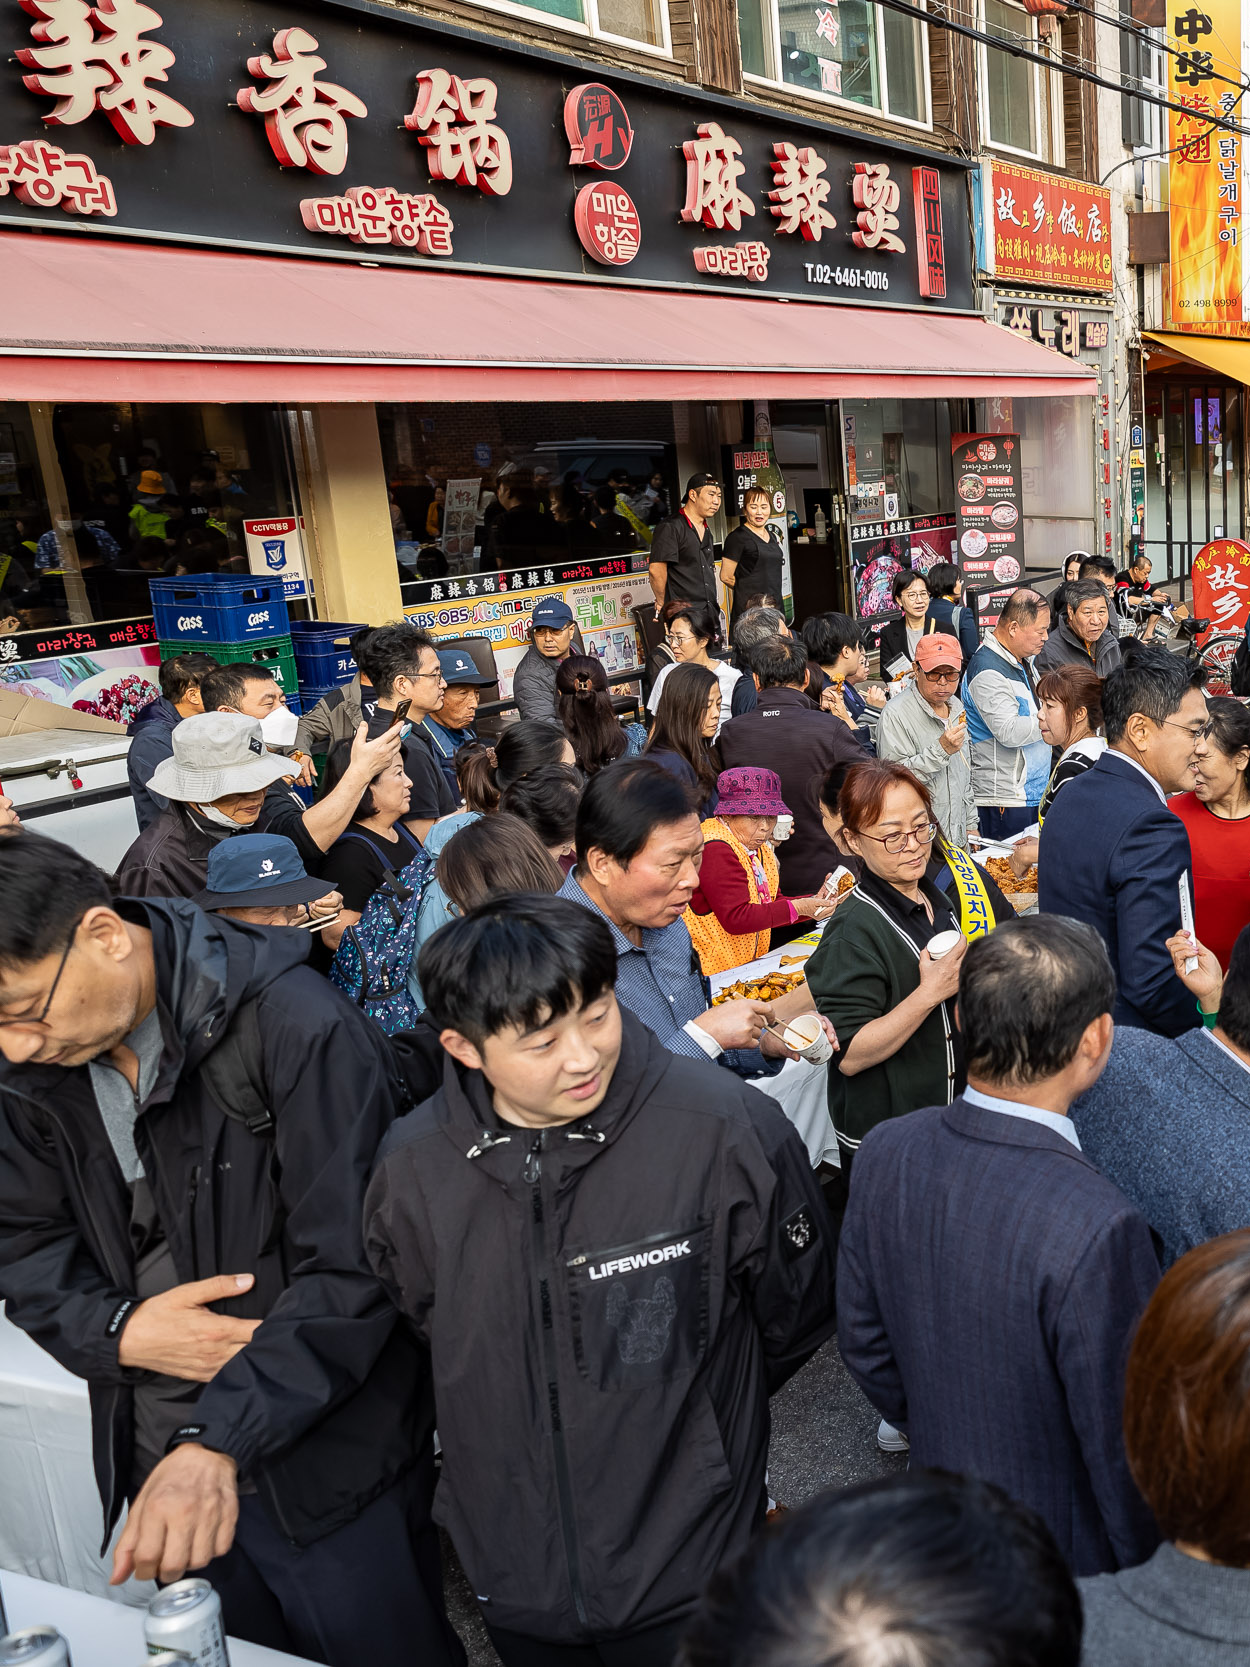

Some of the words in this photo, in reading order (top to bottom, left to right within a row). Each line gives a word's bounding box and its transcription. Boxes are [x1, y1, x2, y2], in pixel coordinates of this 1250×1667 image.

[1174, 8, 1214, 165] 中华烤翅
[681, 121, 906, 254] 麻辣烫
[592, 192, 636, 229] 매운
[995, 187, 1102, 244] 故乡饭店
[922, 169, 945, 297] 四川风味
[697, 243, 771, 282] 마라탕
[805, 262, 889, 291] T.02-6461-0016
[1178, 300, 1191, 308] 02
[1194, 299, 1211, 308] 498
[1214, 298, 1238, 308] 8999
[1085, 321, 1109, 348] 연습장
[430, 576, 495, 601] 麻辣香锅
[178, 614, 203, 633] Cass
[248, 610, 269, 626] Cass
[576, 595, 616, 628] 투데이
[36, 632, 97, 653] 마라샹궈
[762, 710, 780, 718] ROTC
[947, 846, 990, 938] 대양꼬치거
[588, 1240, 692, 1281] LIFEWORK
